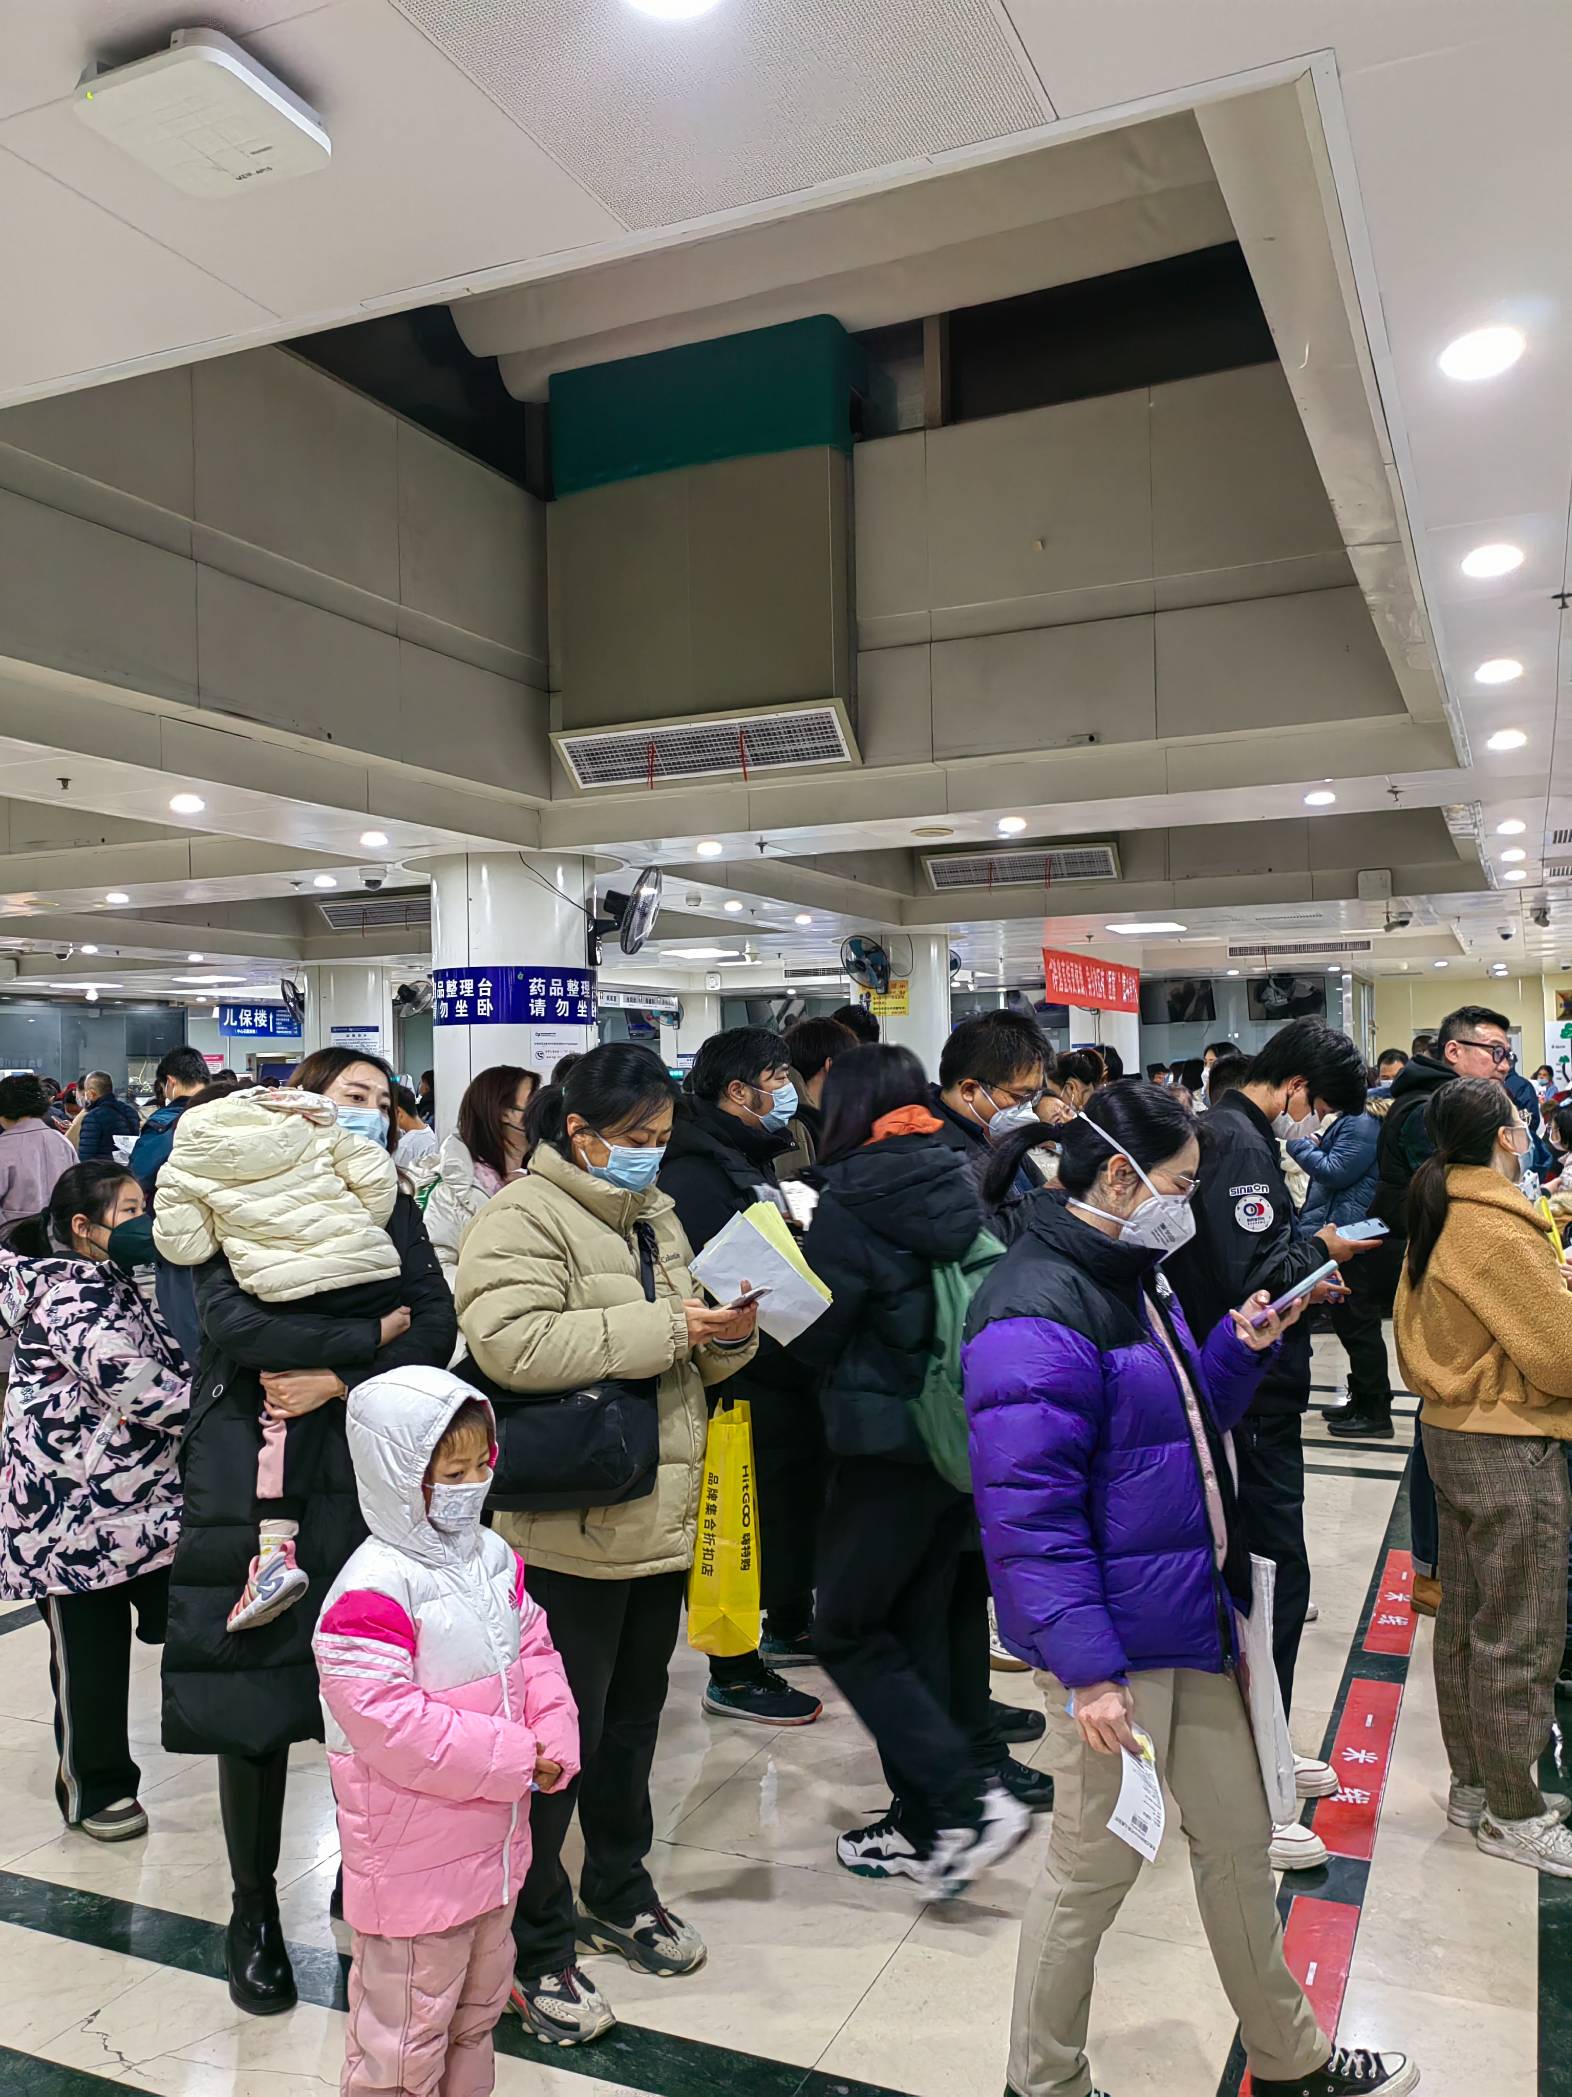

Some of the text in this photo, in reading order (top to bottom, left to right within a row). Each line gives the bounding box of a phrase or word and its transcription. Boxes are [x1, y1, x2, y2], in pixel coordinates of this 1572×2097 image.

[433, 978, 493, 998] 品整理台
[223, 1008, 268, 1028] 儿保楼
[701, 1472, 719, 1577] 品牌集合折扣店
[1329, 1713, 1379, 1804] 一米线
